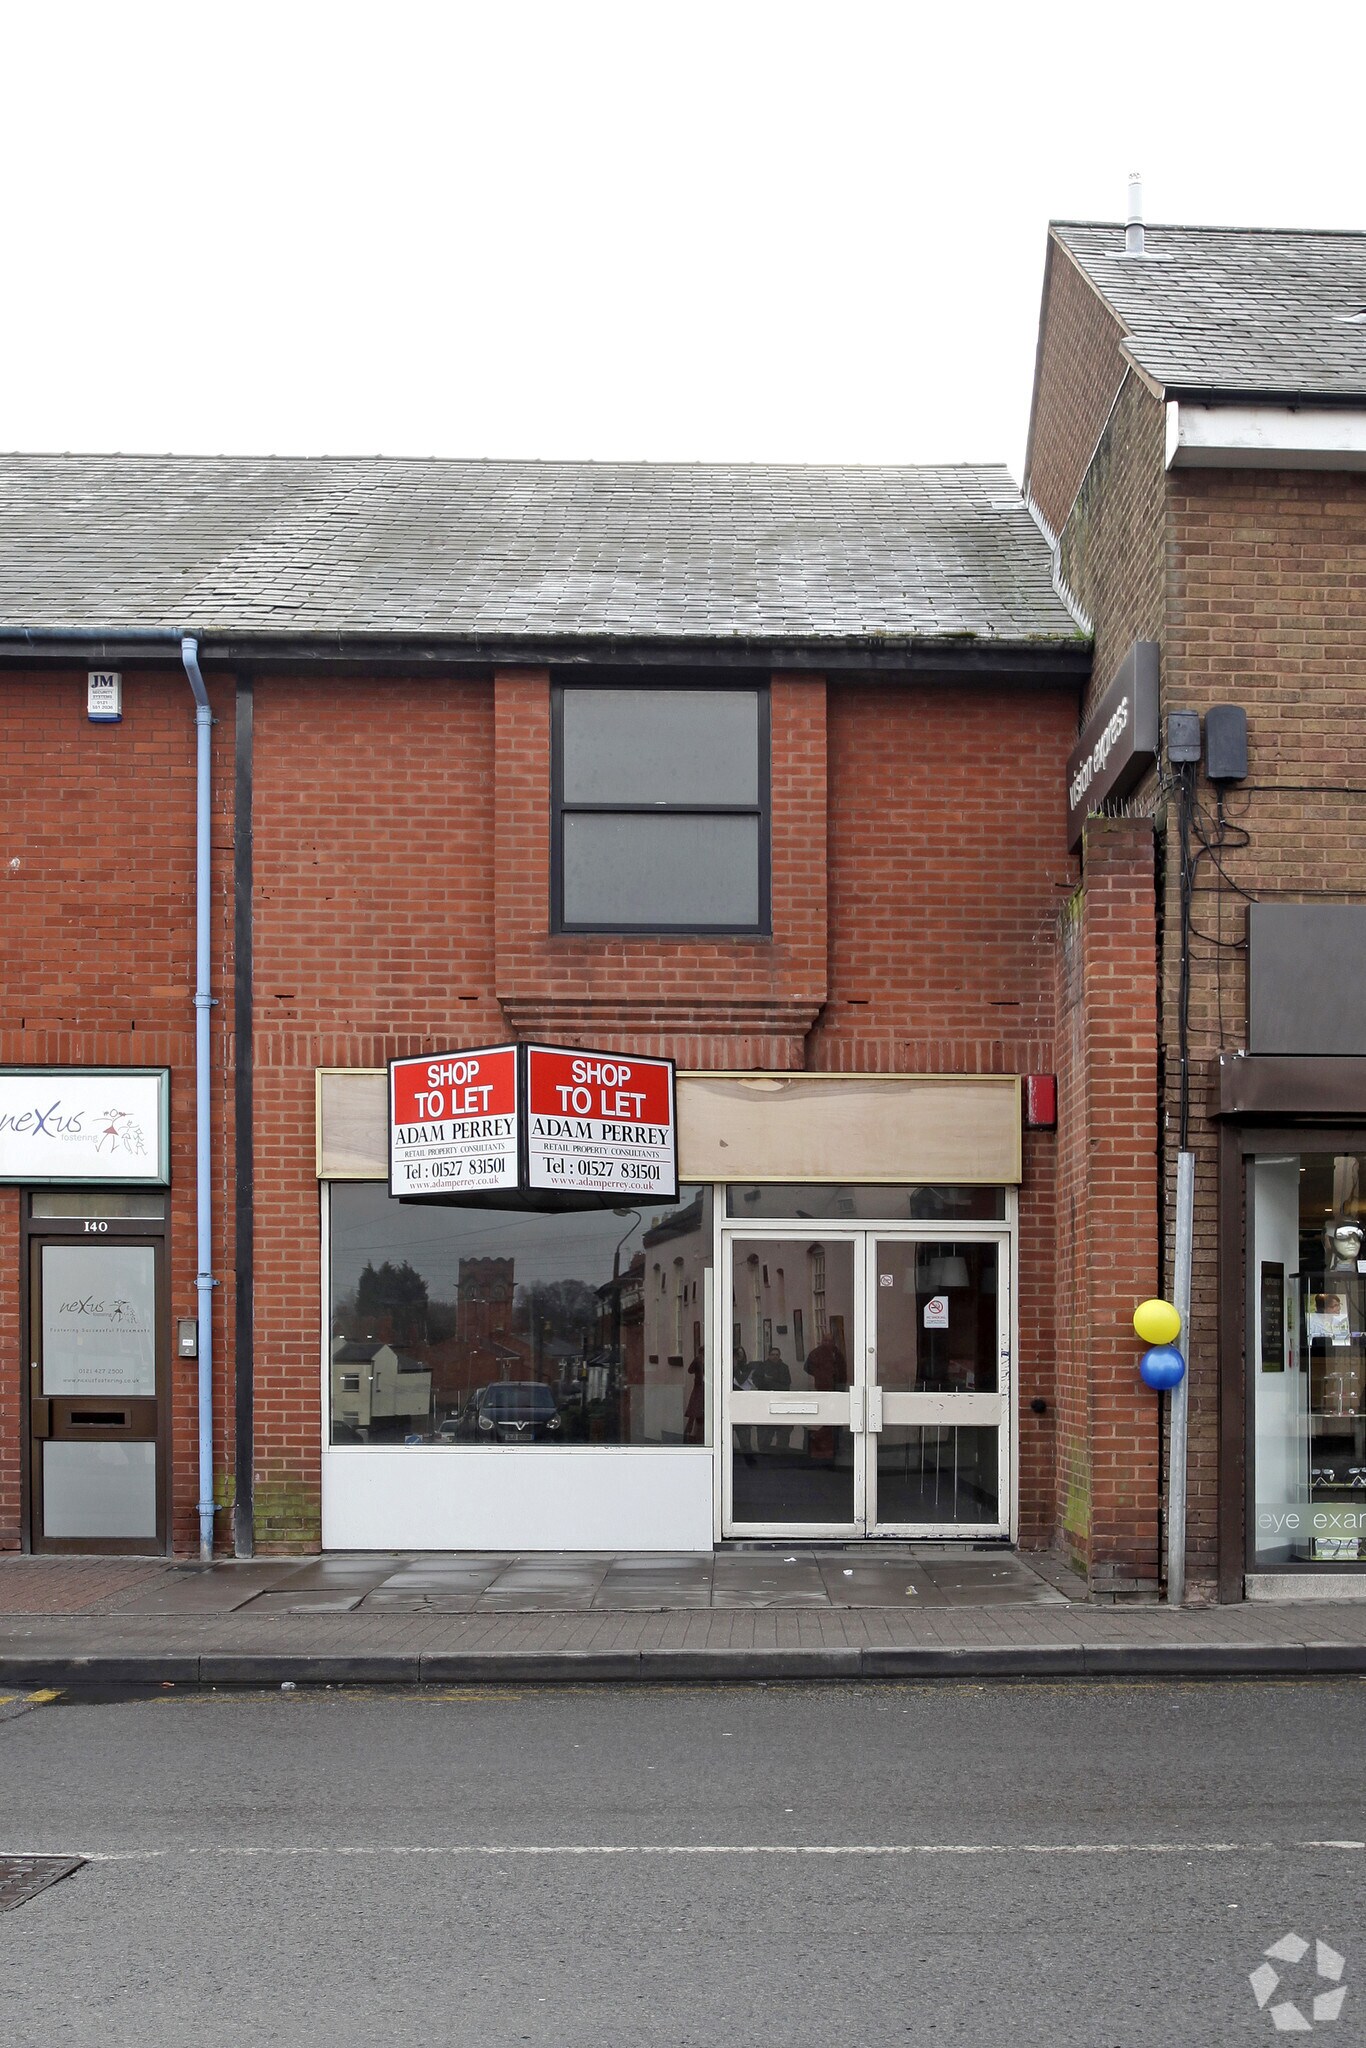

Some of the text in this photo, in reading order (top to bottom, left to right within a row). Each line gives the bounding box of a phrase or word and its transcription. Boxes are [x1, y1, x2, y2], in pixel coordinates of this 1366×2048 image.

[91, 675, 114, 688] JM
[1070, 696, 1128, 811] vision express
[427, 1060, 480, 1088] SHOP
[571, 1059, 631, 1087] SHOP
[414, 1085, 494, 1118] TO LET
[555, 1085, 647, 1119] TO LET
[61, 1133, 98, 1143] fostering
[395, 1117, 515, 1145] ADAM PERREY
[532, 1118, 669, 1145] ADAM PERREY
[404, 1142, 505, 1158] RETAIL PROPERTY CONSULTANTS
[543, 1143, 660, 1159] RETAIL PROPERTY CONSULTANTS
[431, 1160, 463, 1178] 01527
[469, 1157, 506, 1175] 831501
[577, 1159, 614, 1177] 01527
[620, 1162, 661, 1180] 831501
[409, 1175, 500, 1190] www.adamperrey.co.uk
[550, 1176, 655, 1191] www.adamperrey.co.uk
[83, 1221, 108, 1232] 140
[1258, 1513, 1300, 1533] eye
